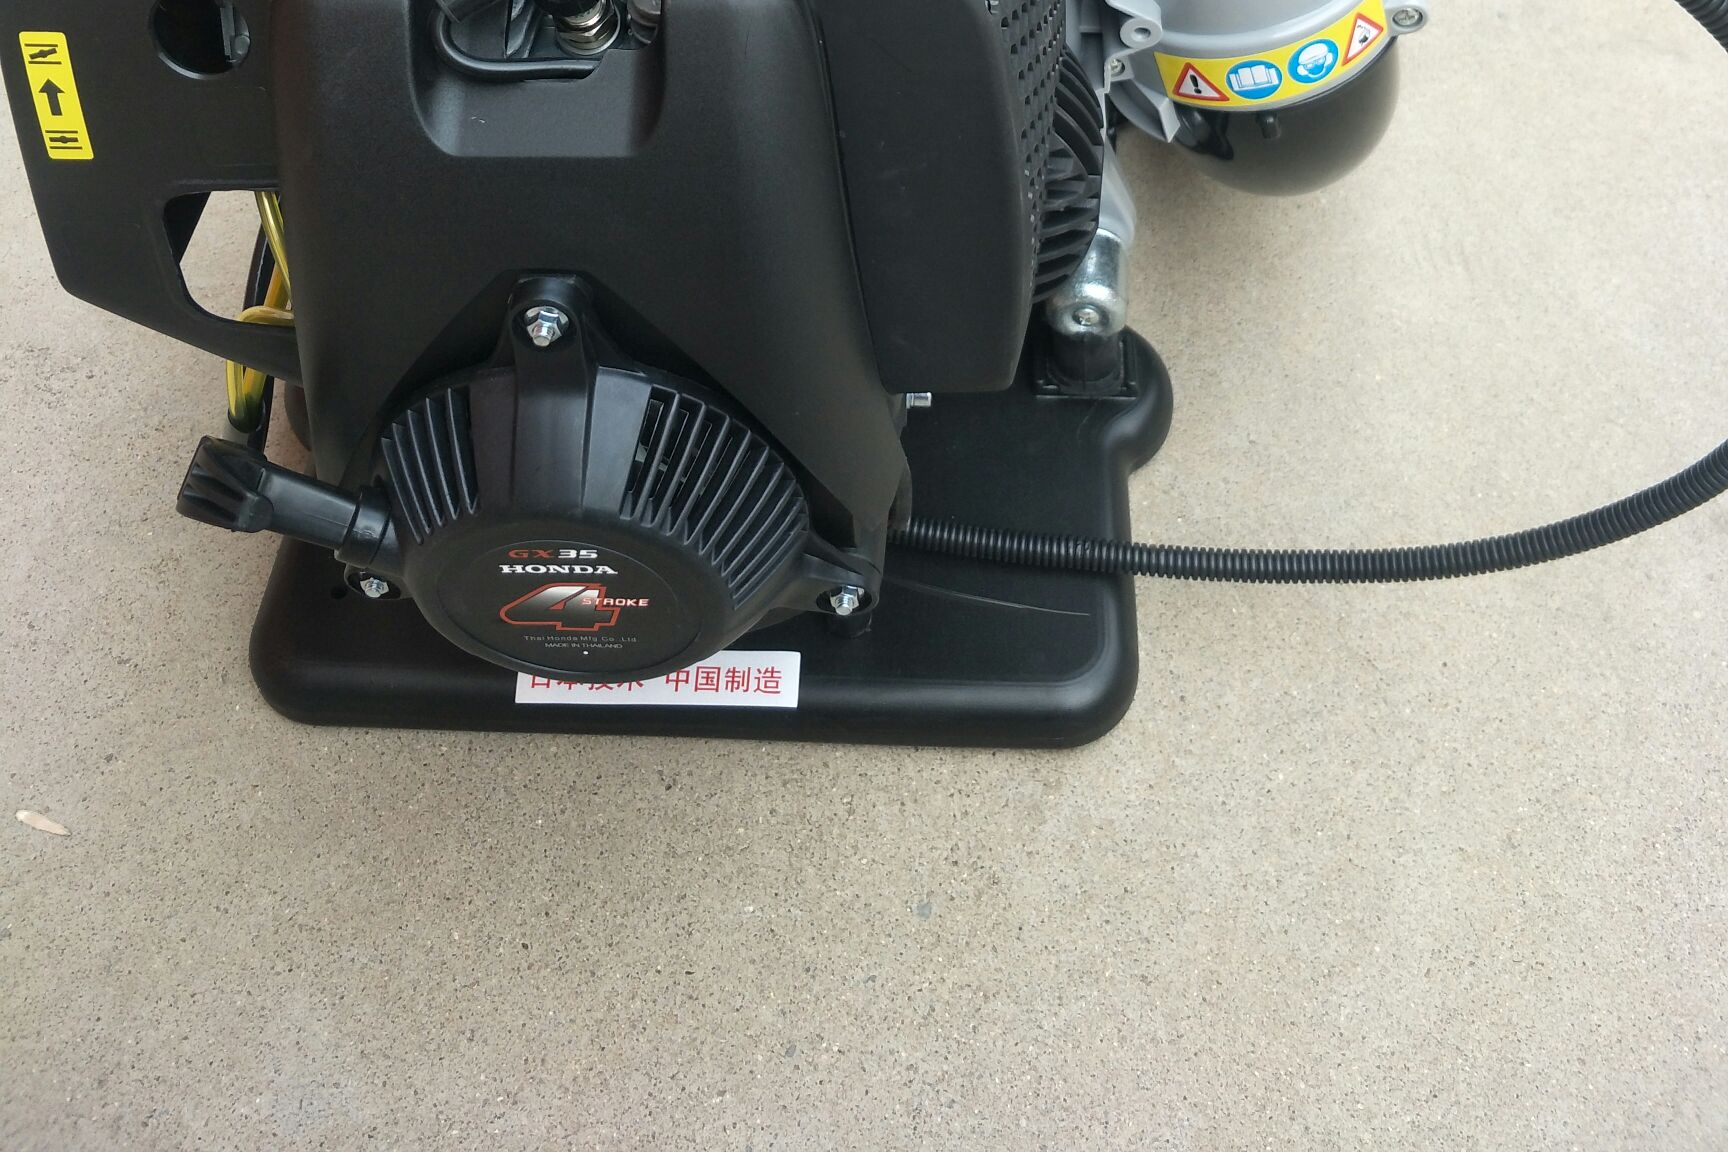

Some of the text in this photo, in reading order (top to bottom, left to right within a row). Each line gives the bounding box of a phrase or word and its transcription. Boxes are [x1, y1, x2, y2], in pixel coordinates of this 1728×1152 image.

[499, 564, 618, 574] HONDA
[500, 582, 649, 630] 4 STROKE
[664, 666, 783, 695] 中国制造
